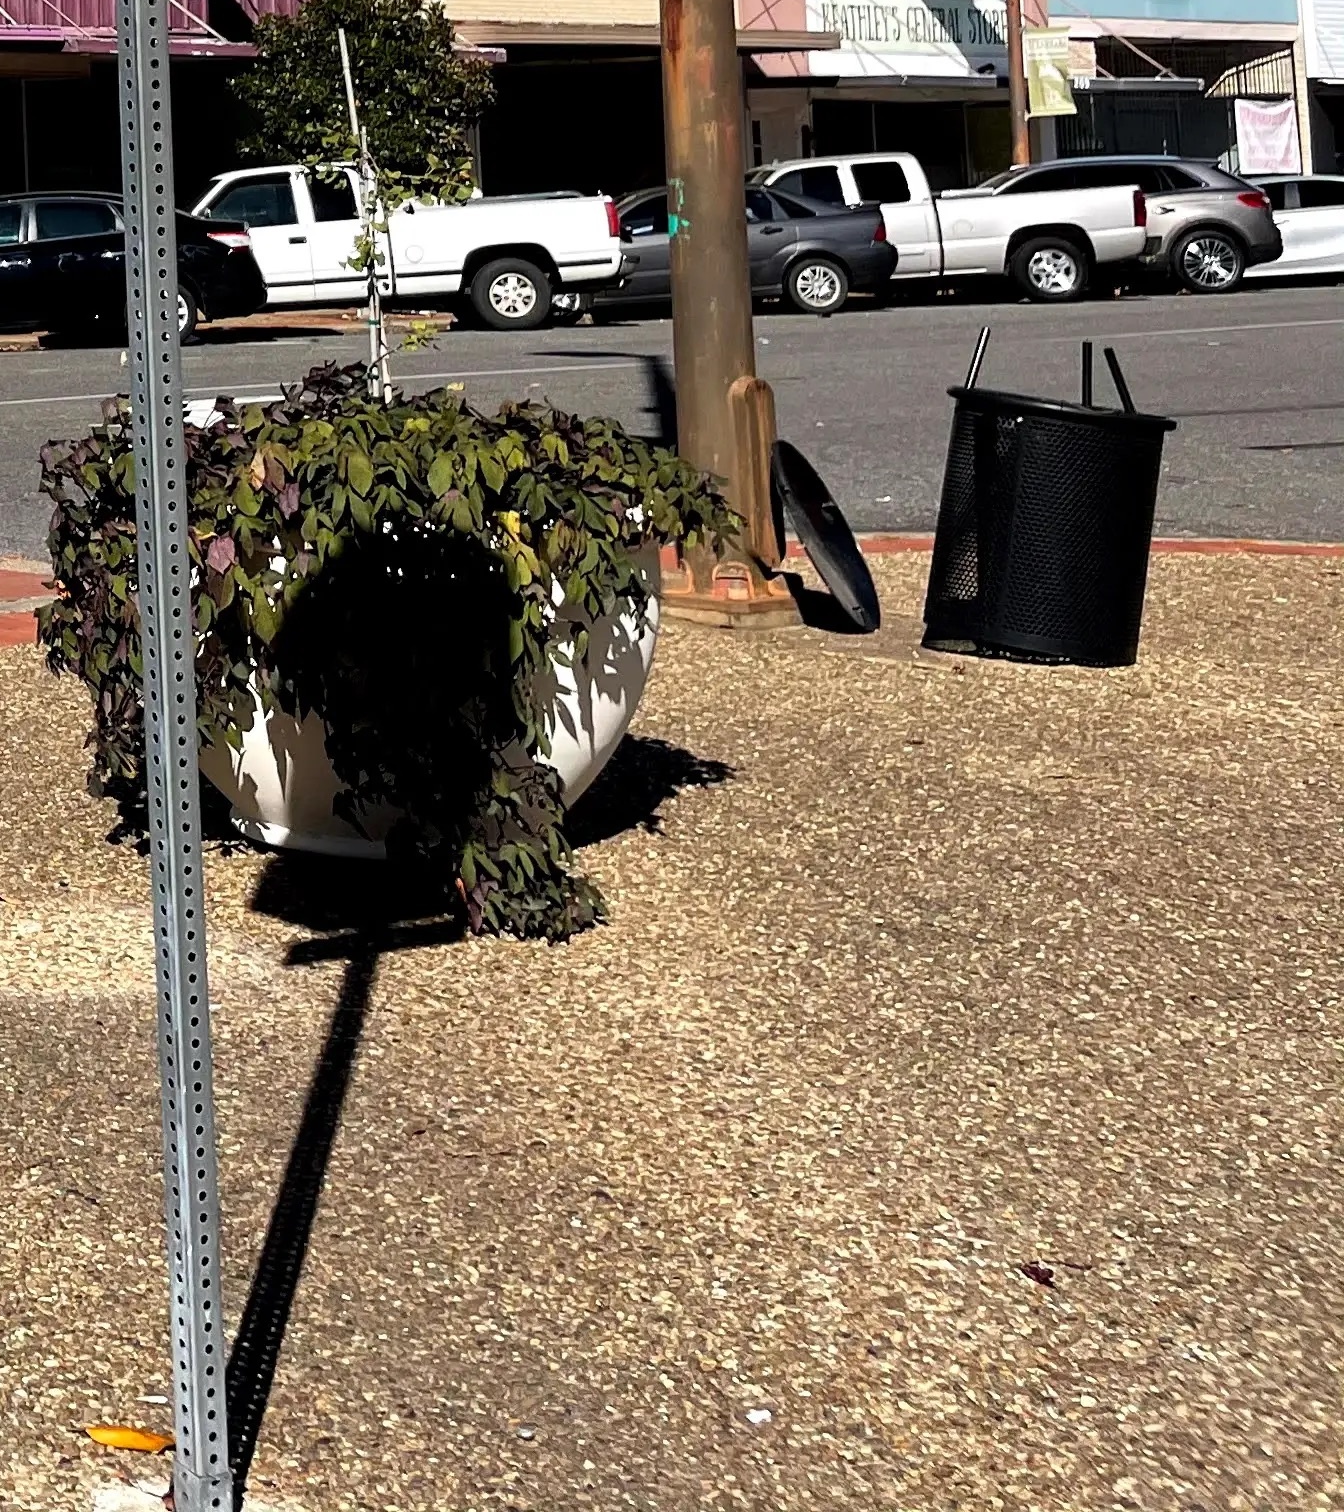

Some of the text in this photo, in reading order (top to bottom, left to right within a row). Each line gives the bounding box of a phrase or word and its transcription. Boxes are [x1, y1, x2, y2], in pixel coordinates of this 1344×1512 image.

[821, 2, 1008, 45] KEATHLEY'S GENERAL STORE
